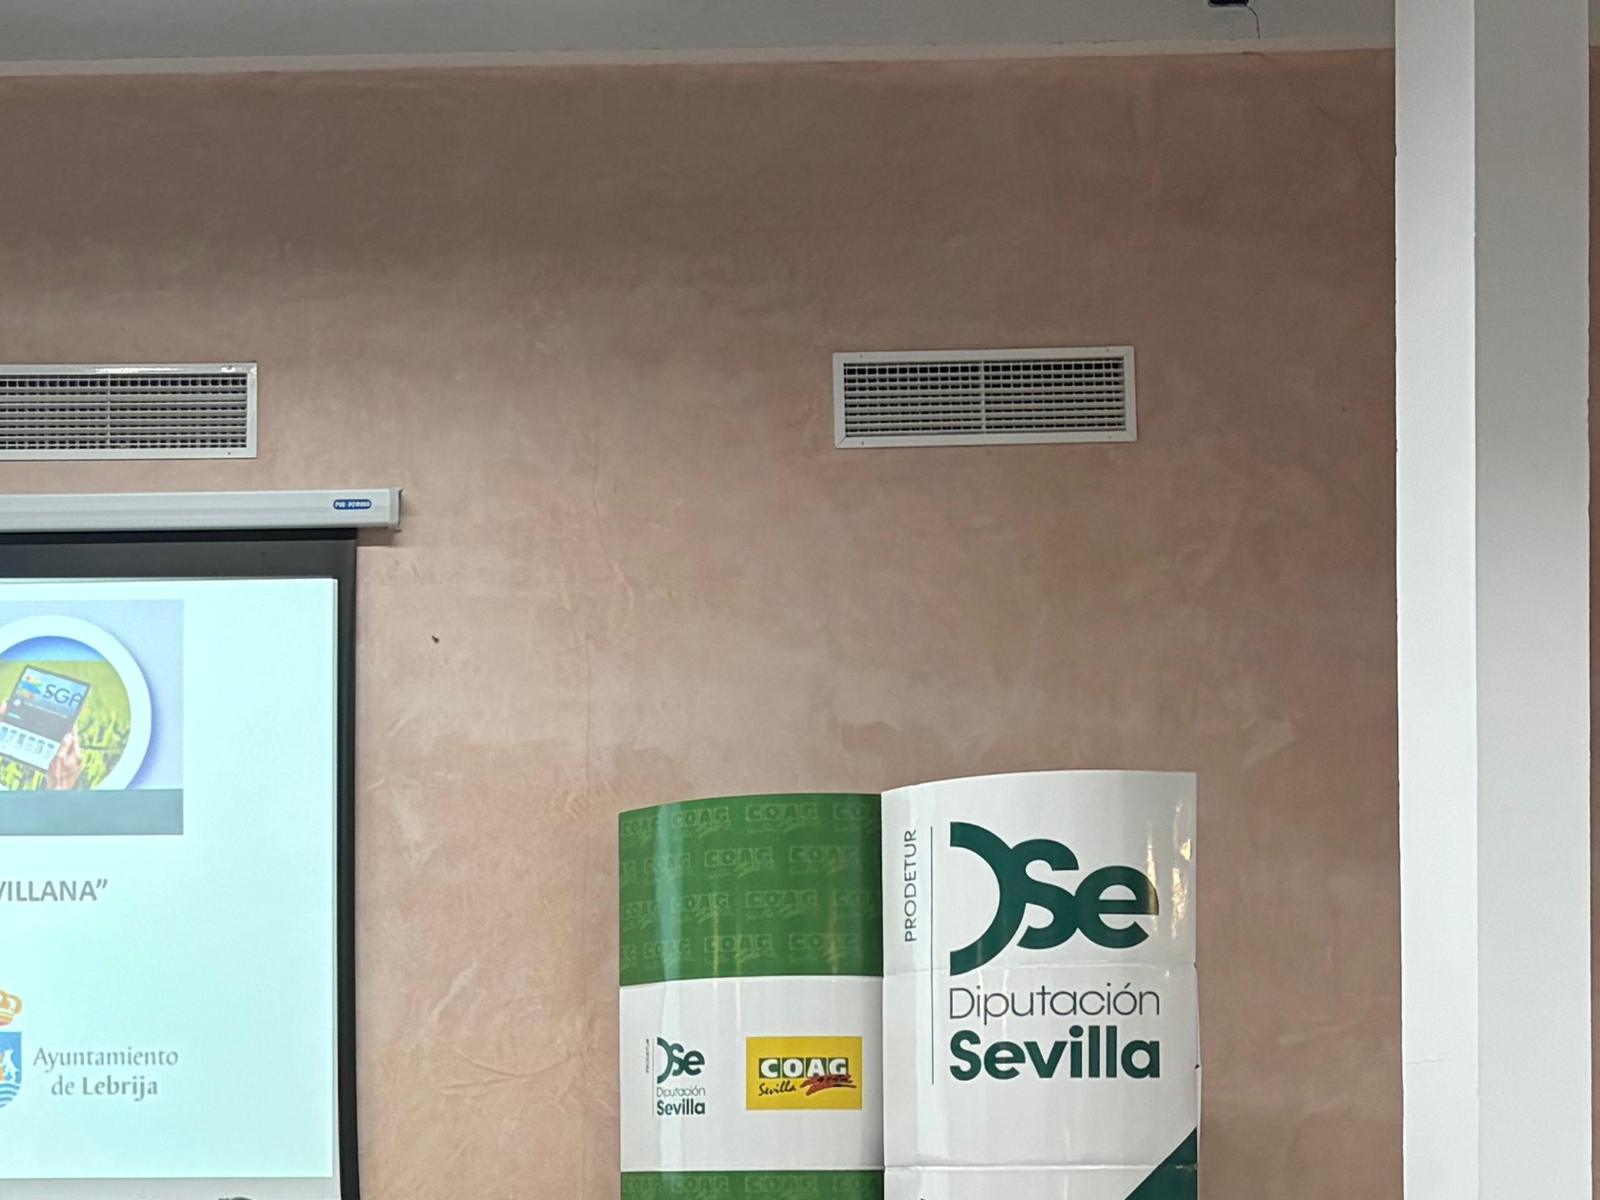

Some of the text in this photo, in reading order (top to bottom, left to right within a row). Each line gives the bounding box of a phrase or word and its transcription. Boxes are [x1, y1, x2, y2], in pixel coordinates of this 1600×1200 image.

[904, 829, 917, 942] PRODETUR
[950, 983, 1160, 1025] Diputación
[33, 1047, 178, 1073] Ayuntamiento
[950, 1025, 1160, 1081] Sevilla
[759, 1058, 848, 1078] COAG
[51, 1076, 158, 1101] de Lebrija
[657, 1085, 705, 1098] Diputación
[758, 1081, 796, 1096] Sevilla
[657, 1099, 705, 1115] Sevilla
